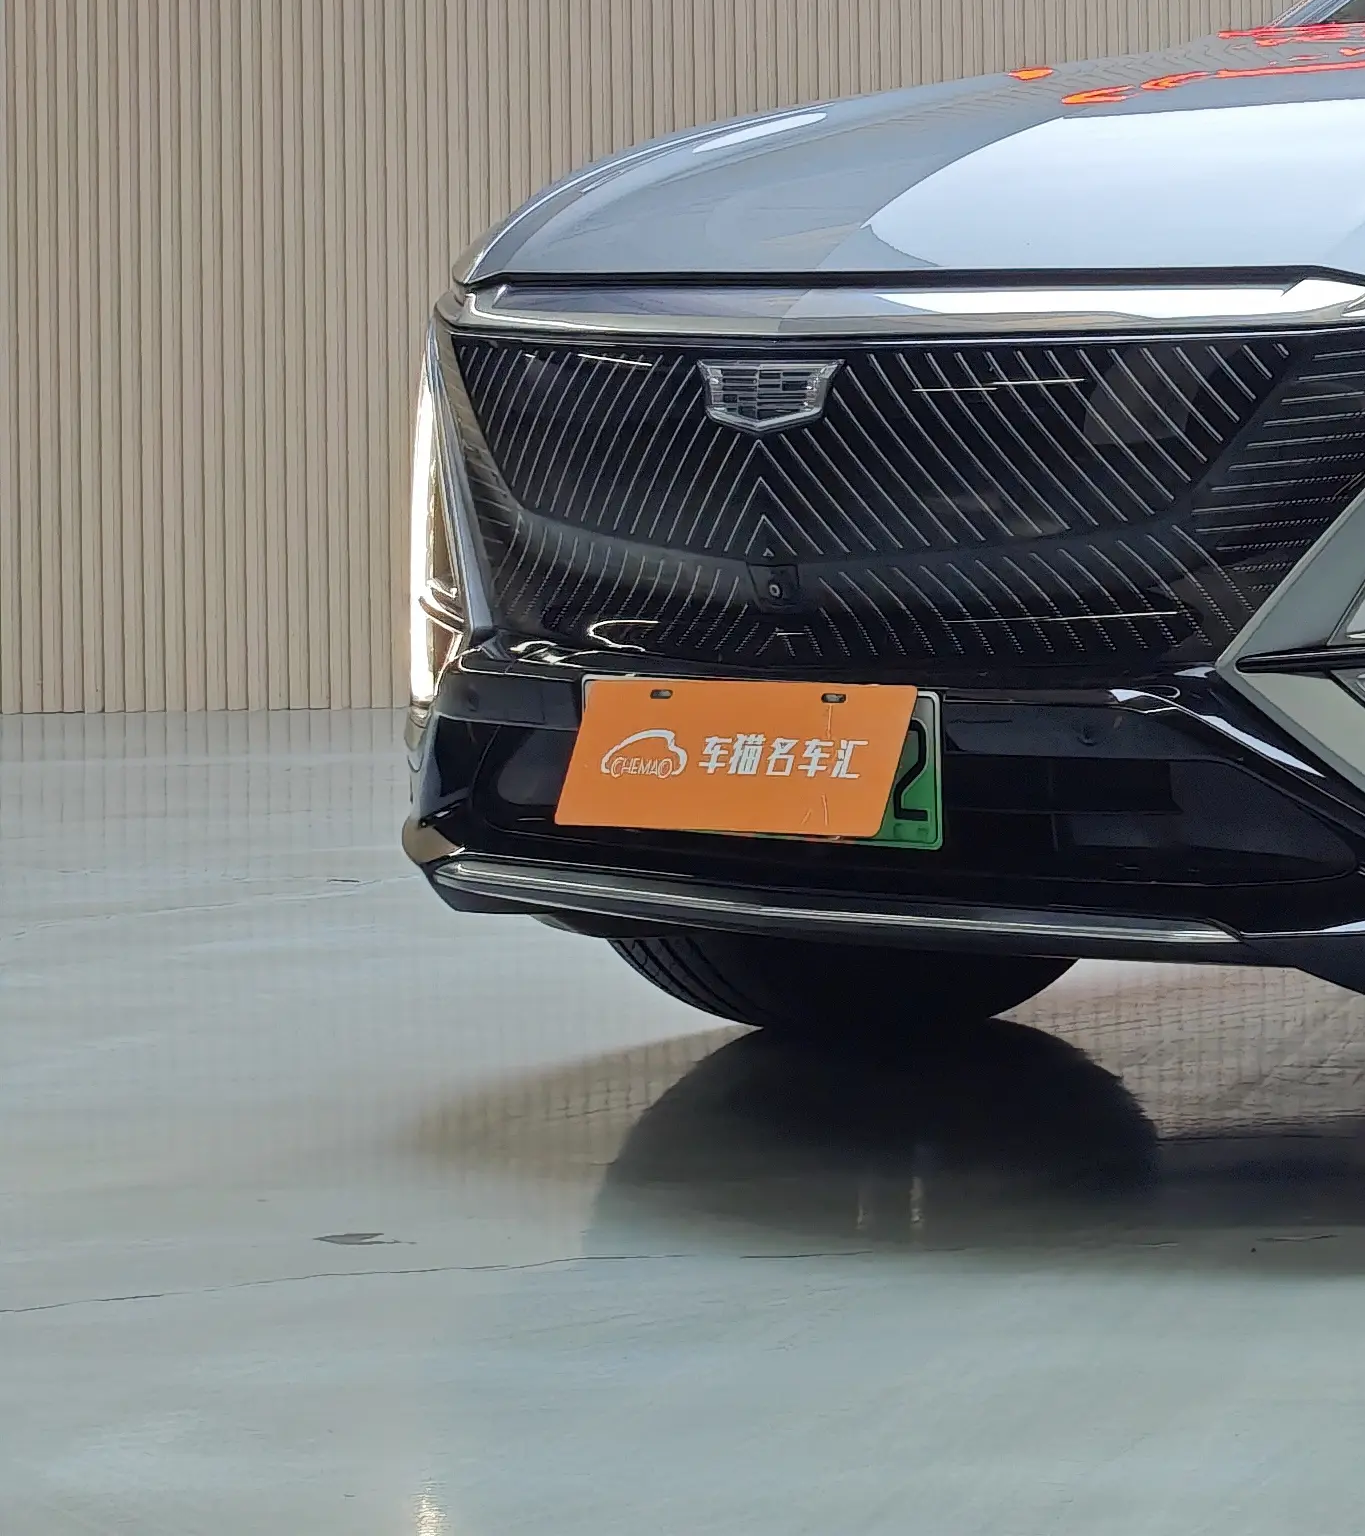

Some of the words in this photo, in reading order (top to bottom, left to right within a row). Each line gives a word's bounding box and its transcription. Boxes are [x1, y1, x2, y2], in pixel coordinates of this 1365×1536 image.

[610, 756, 673, 778] CHEMAO
[699, 733, 869, 779] 车猫名车汇
